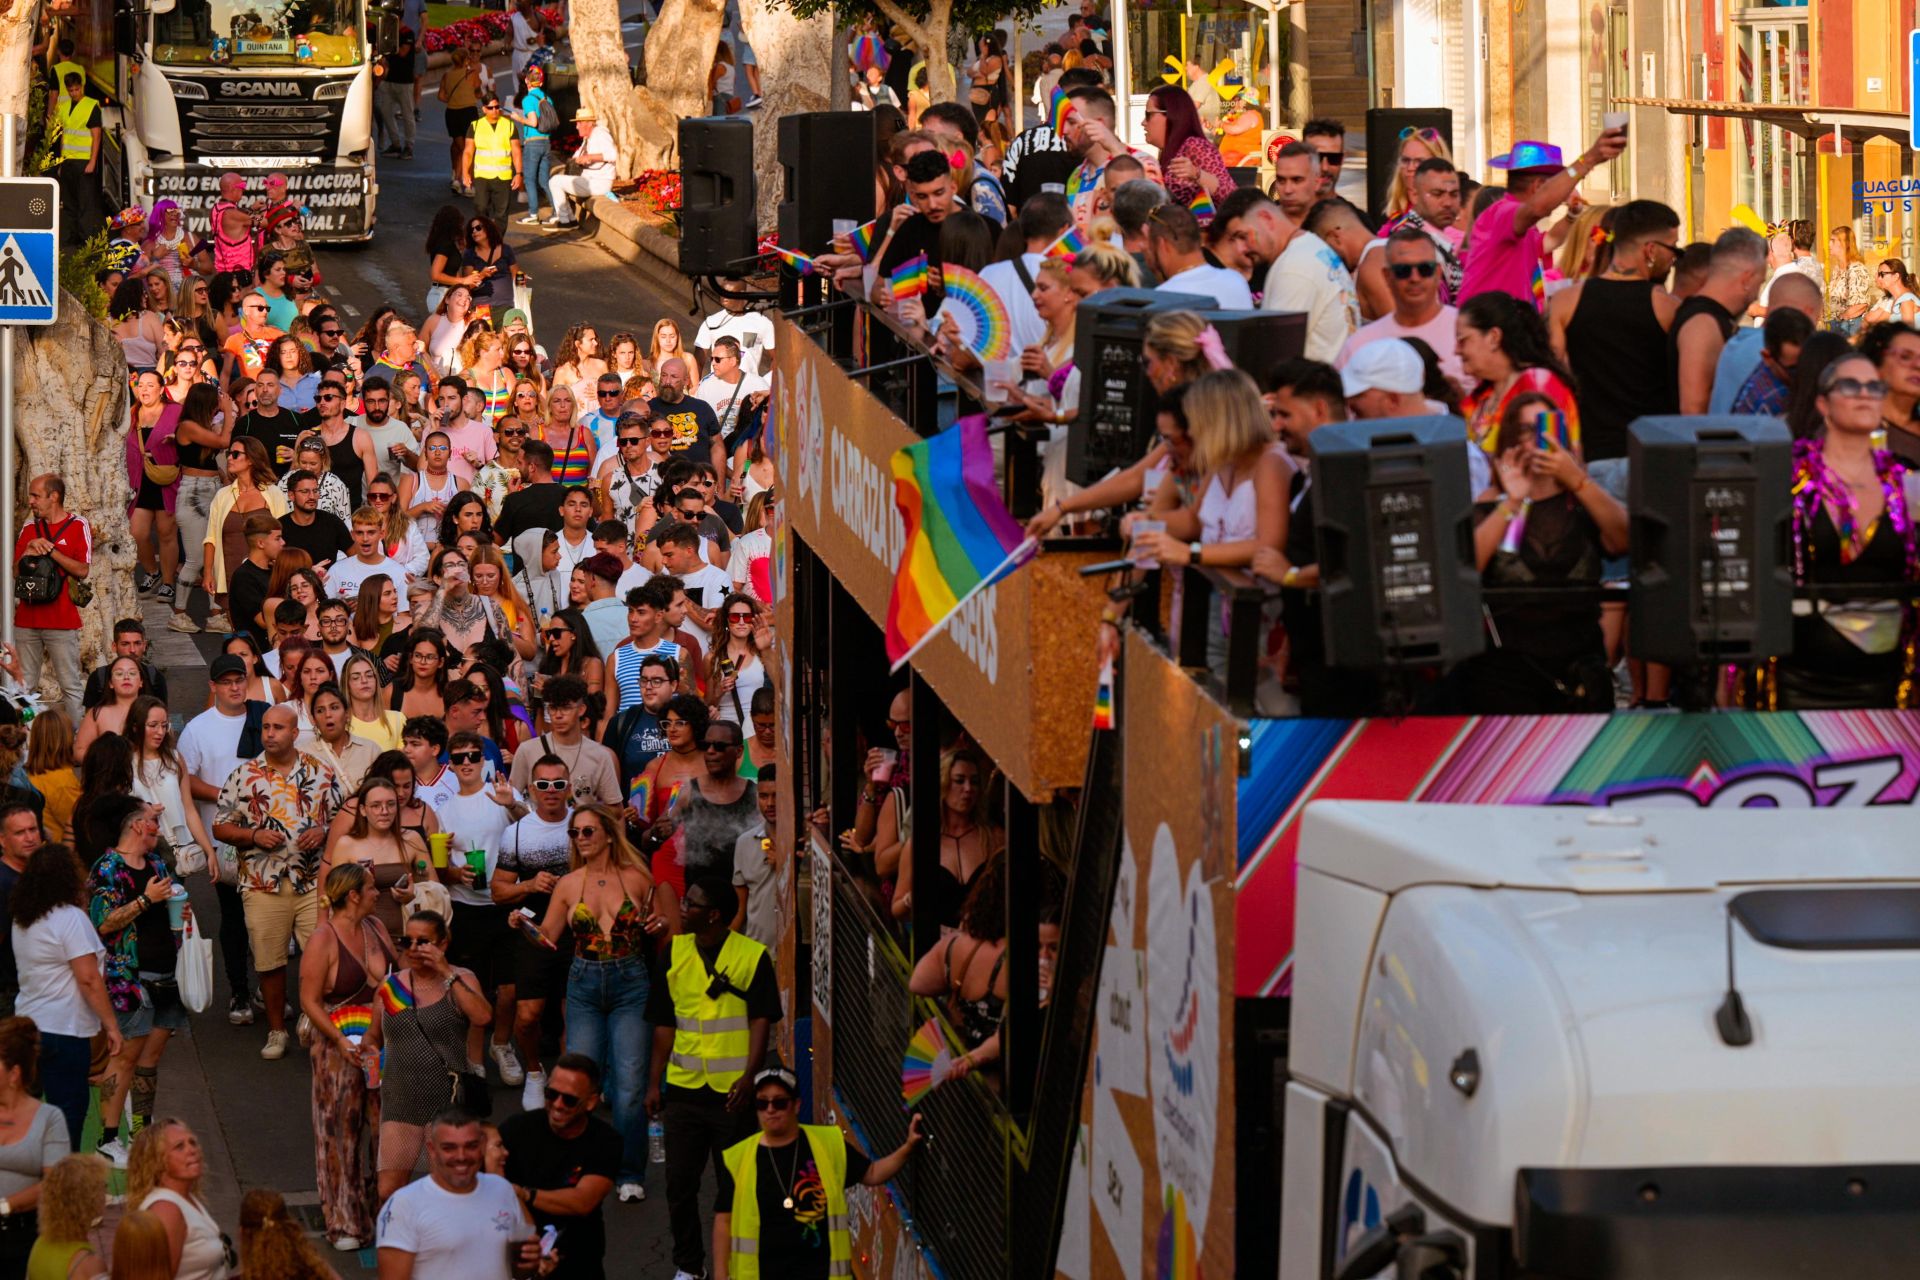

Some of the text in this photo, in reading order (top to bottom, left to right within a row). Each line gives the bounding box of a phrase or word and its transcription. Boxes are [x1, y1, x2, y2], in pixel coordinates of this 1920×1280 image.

[246, 43, 283, 51] QUINTANA
[220, 81, 301, 97] SCANIA
[159, 175, 198, 191] SOLO
[304, 173, 361, 190] LOCURA
[308, 189, 362, 207] PASIÓN
[831, 424, 889, 568] CARROZA
